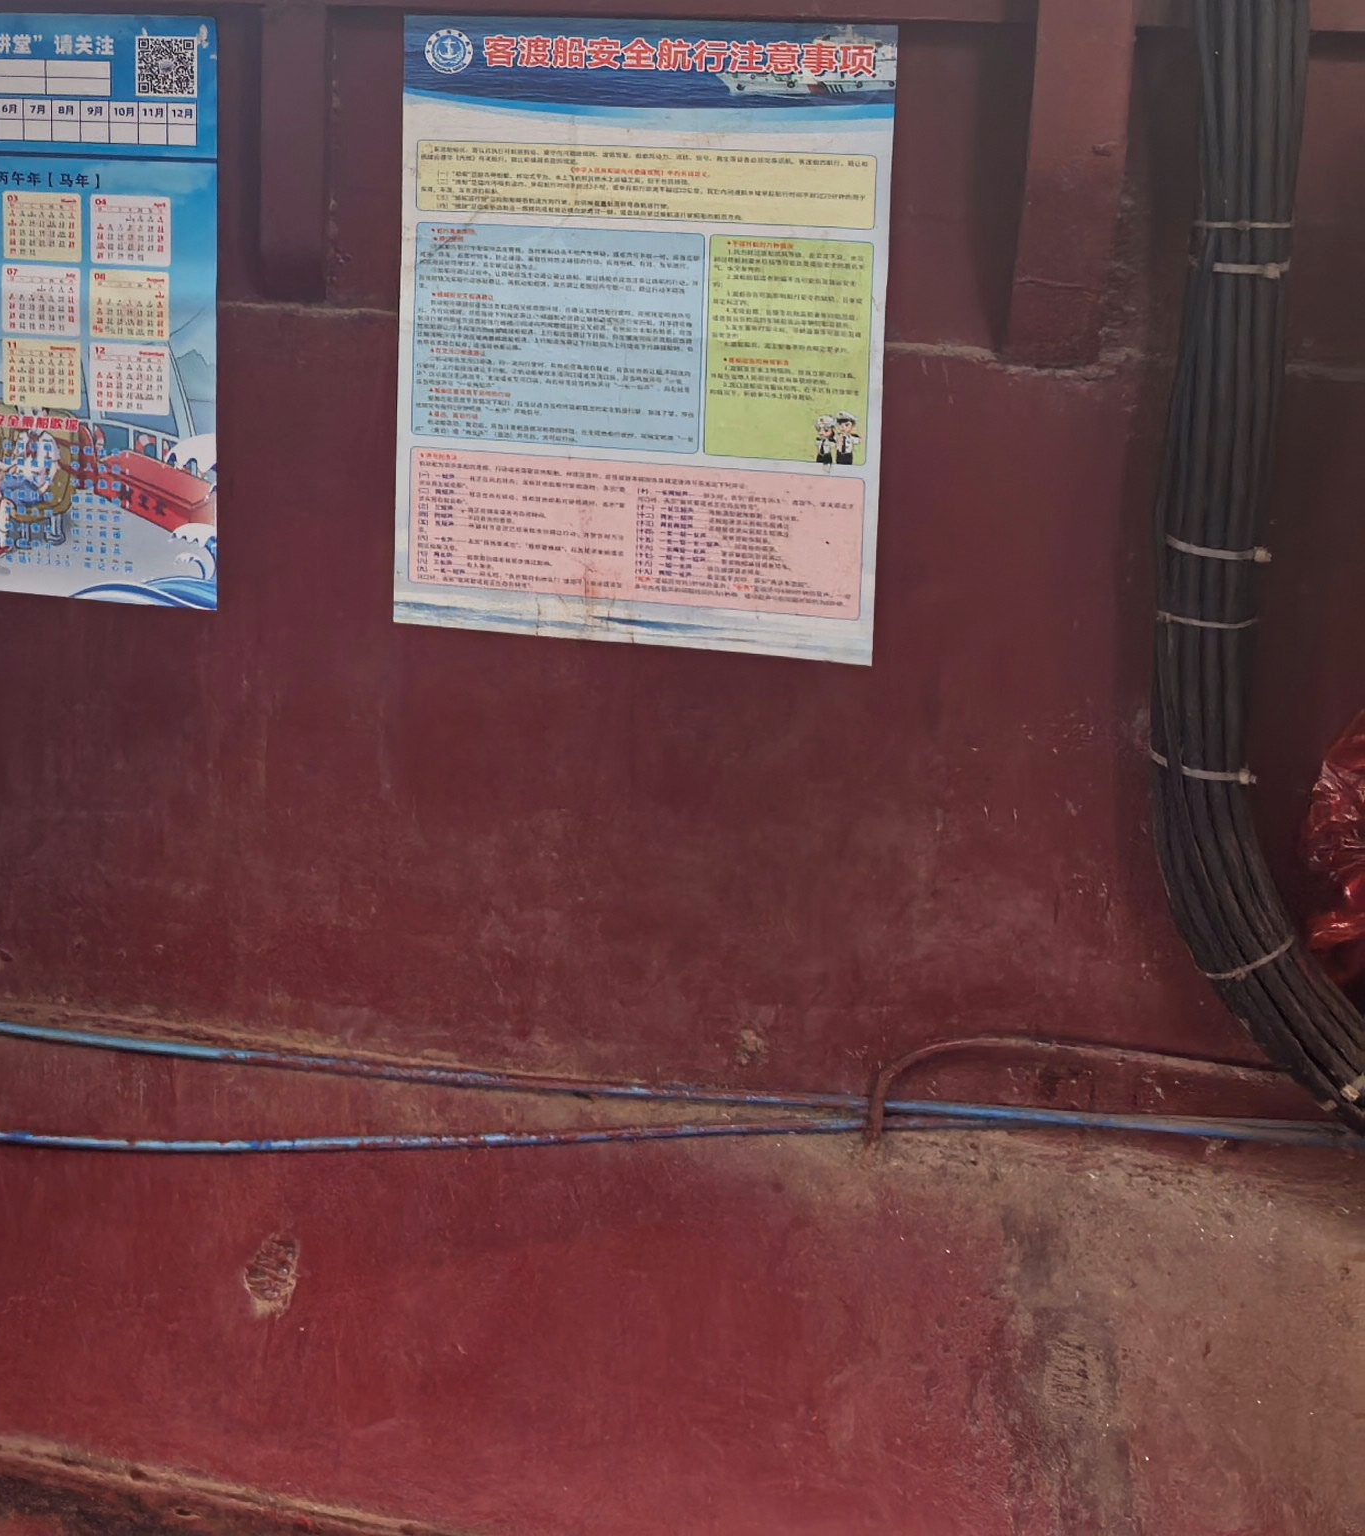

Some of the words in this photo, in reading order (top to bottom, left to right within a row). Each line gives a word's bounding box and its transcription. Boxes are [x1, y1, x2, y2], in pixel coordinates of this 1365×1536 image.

[54, 34, 115, 56] 请关注
[482, 35, 878, 77] 客渡船安全航行注意事项
[1, 103, 17, 114] 6月
[30, 104, 46, 115] 7月
[58, 105, 74, 116] 8月
[87, 106, 103, 116] 9月
[113, 107, 135, 117] 10月
[142, 108, 163, 118] 11月
[171, 108, 193, 119] 12月
[6, 268, 18, 276] 07
[94, 273, 105, 281] 08
[6, 341, 17, 349] 11
[94, 346, 105, 354] 12
